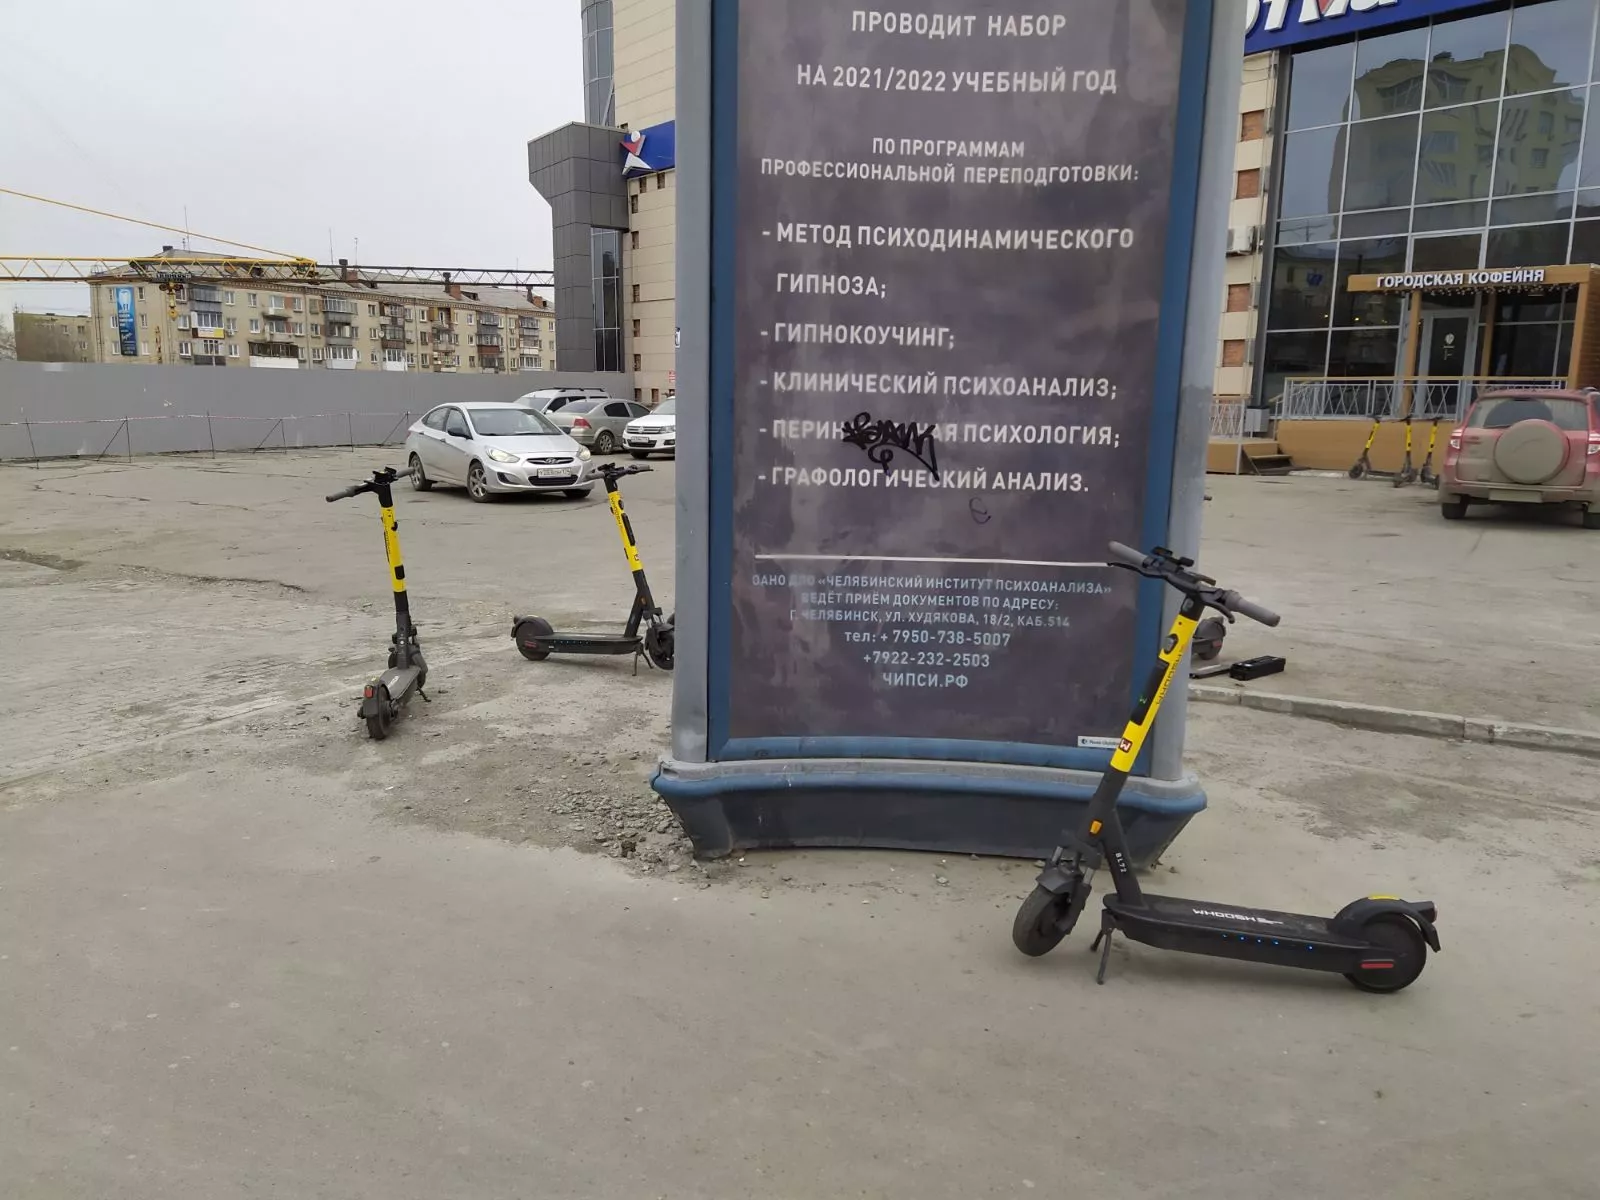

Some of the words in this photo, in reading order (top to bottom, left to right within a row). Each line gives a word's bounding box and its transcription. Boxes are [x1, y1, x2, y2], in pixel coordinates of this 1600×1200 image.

[852, 10, 977, 40] ПРОВОДИТ
[987, 14, 1066, 37] НАБОР
[797, 63, 827, 86] НА
[832, 65, 946, 92] 2021/2022
[951, 66, 1066, 93] УЧЕБНЫЙ
[1072, 69, 1117, 95] ГОД
[872, 137, 896, 155] ПО
[900, 138, 1025, 158] ПРОГРАММАМ
[761, 158, 955, 183] ПРОФЕССИОНАЛЬНОЙ
[963, 164, 1139, 187] ПЕРЕПОДГОТОВКИ:
[777, 222, 852, 249] МЕТОД
[857, 225, 1134, 252] ПСИХОДИНАМИЧЕСКОГО
[776, 272, 886, 299] ГИПНОЗА;
[1376, 272, 1464, 289] ГОРОДСКАЯ
[1467, 266, 1545, 285] КОФЕЙНЯ
[774, 322, 955, 350] ГИПНОКОУЧИНГ;
[773, 371, 938, 395] КЛИНИЧЕСКИЙ
[943, 375, 1117, 400] ПСИХОАНАЛИЗ;
[963, 423, 1120, 449] ПСИХОЛОГИЯ;
[772, 466, 987, 490] ГРАФОЛОГИЧЕСКИЙ
[991, 471, 1089, 492] АНАЛИЗ.
[925, 577, 994, 590] ИНСТИТУТ
[995, 578, 1112, 594] ПСИХОАНАЛИЗА»
[845, 591, 890, 605] ПРИЁМ
[892, 594, 980, 607] ДОКУМЕНТОВ
[982, 596, 1000, 608] ПО
[1003, 598, 1059, 611] АДРЕСУ:
[801, 609, 882, 624] ЧЕЛЯБИНСК,
[885, 611, 905, 622] УЛ.
[908, 611, 979, 626] ХУДЯКОВА,
[983, 613, 1014, 628] 18/2,
[844, 631, 876, 643] тел:
[892, 629, 1011, 647] 7950-738-5007
[863, 650, 990, 668] +7922-232-2503
[882, 672, 969, 689] ЧИПСИ.РФ
